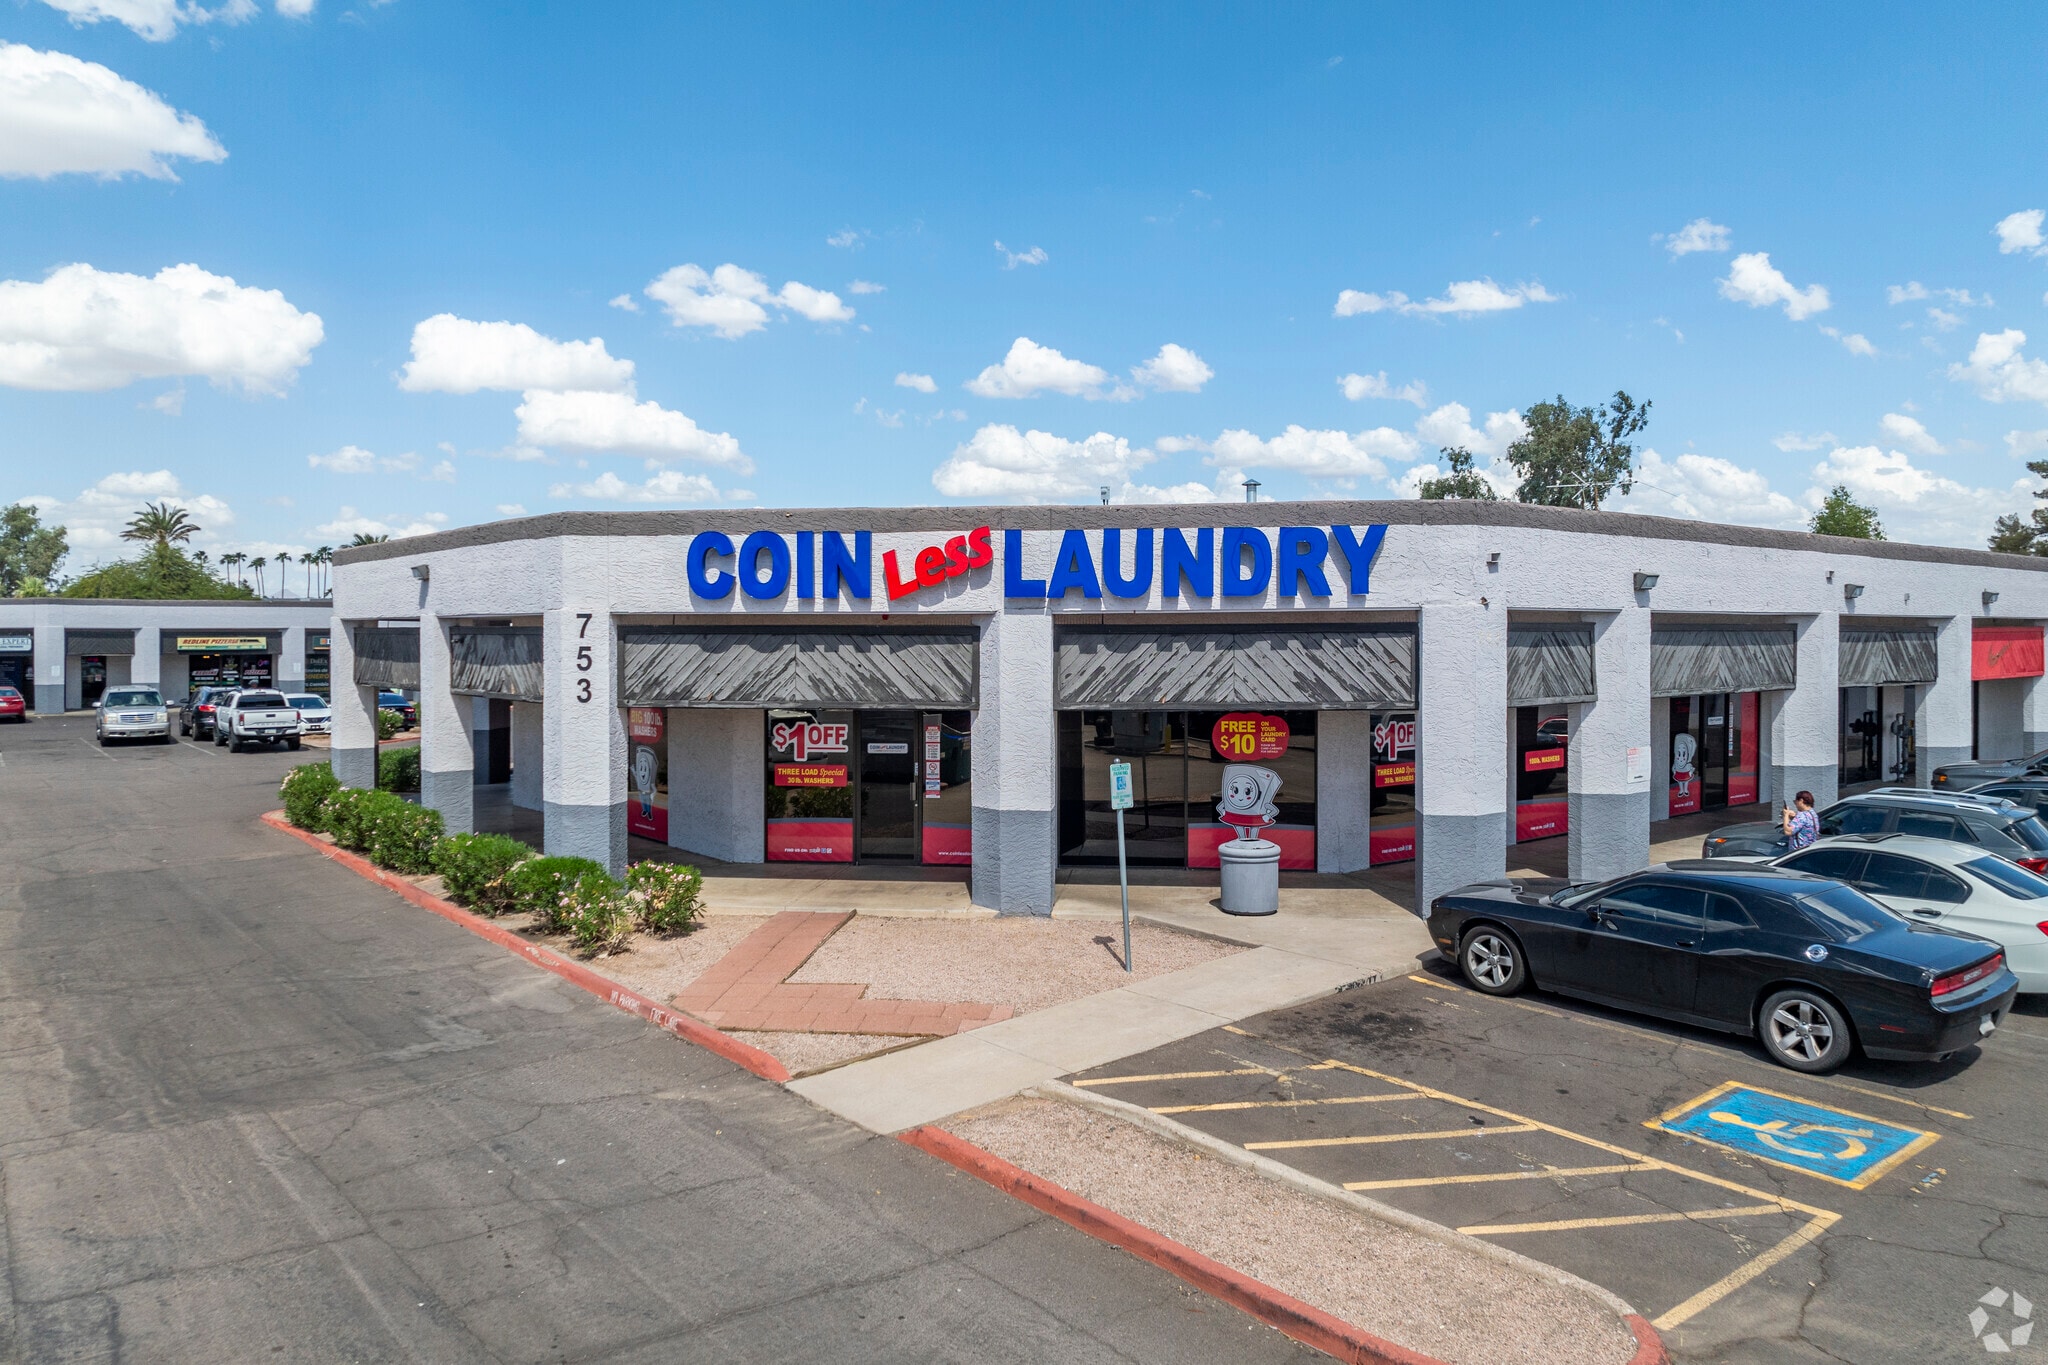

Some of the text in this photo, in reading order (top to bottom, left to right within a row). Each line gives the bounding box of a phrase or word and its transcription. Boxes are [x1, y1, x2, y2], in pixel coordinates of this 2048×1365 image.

[687, 524, 1388, 601] COIN Less LAUNDRY
[2, 638, 29, 646] EXPERT
[631, 709, 663, 726] BIG 100 lb.
[634, 725, 657, 737] WASHERS
[1221, 721, 1256, 733] FREE
[775, 724, 846, 759] $1 OFF
[1221, 734, 1256, 754] $10
[1375, 723, 1415, 759] $1 OF
[1541, 755, 1560, 763] WASHERS
[778, 768, 800, 776] THREE
[820, 768, 845, 777] Special
[1377, 768, 1393, 776] THREE
[1393, 766, 1406, 774] LOAD
[619, 993, 640, 1013] PARKING
